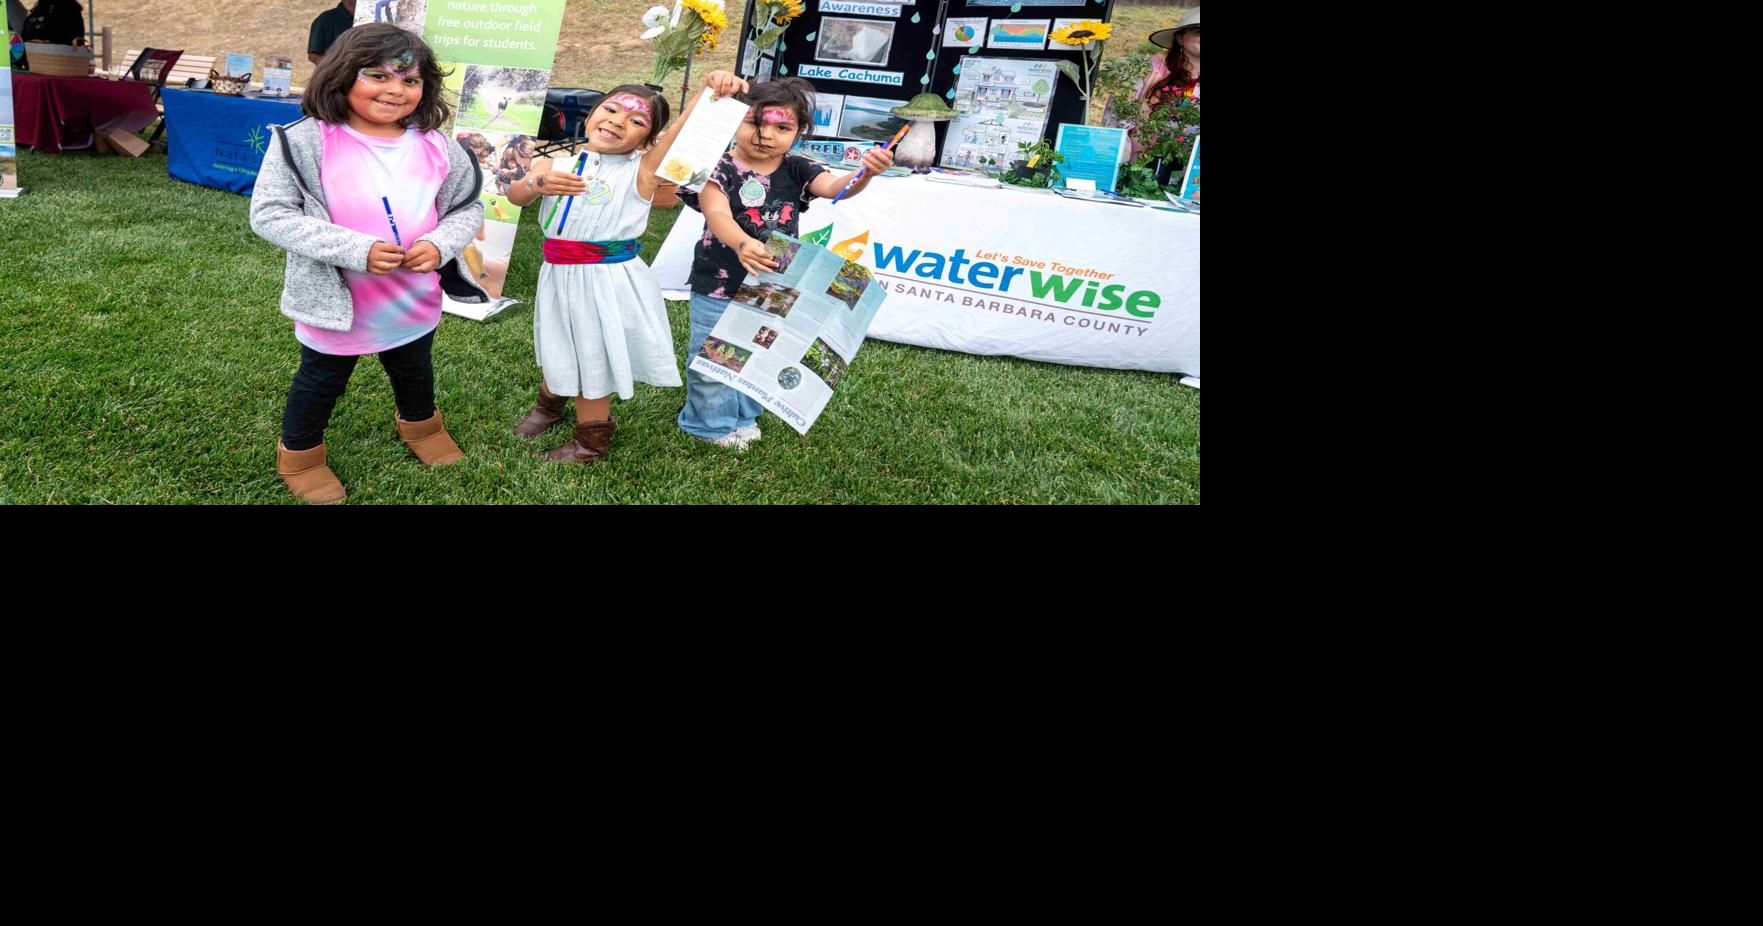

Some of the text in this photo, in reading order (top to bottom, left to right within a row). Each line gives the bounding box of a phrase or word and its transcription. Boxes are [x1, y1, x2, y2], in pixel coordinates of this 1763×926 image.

[447, 0, 537, 16] nature through
[821, 1, 898, 15] Awareness
[438, 16, 542, 32] free outdoor field
[434, 34, 536, 50] trips for students.
[799, 65, 901, 83] Lake Cachuma
[801, 143, 843, 154] FREE
[975, 249, 1115, 281] Let's Save Together
[895, 283, 956, 304] SANTA
[962, 295, 1056, 323] BARBARA
[1063, 315, 1149, 338] COUNTY
[736, 375, 775, 403] Plantas
